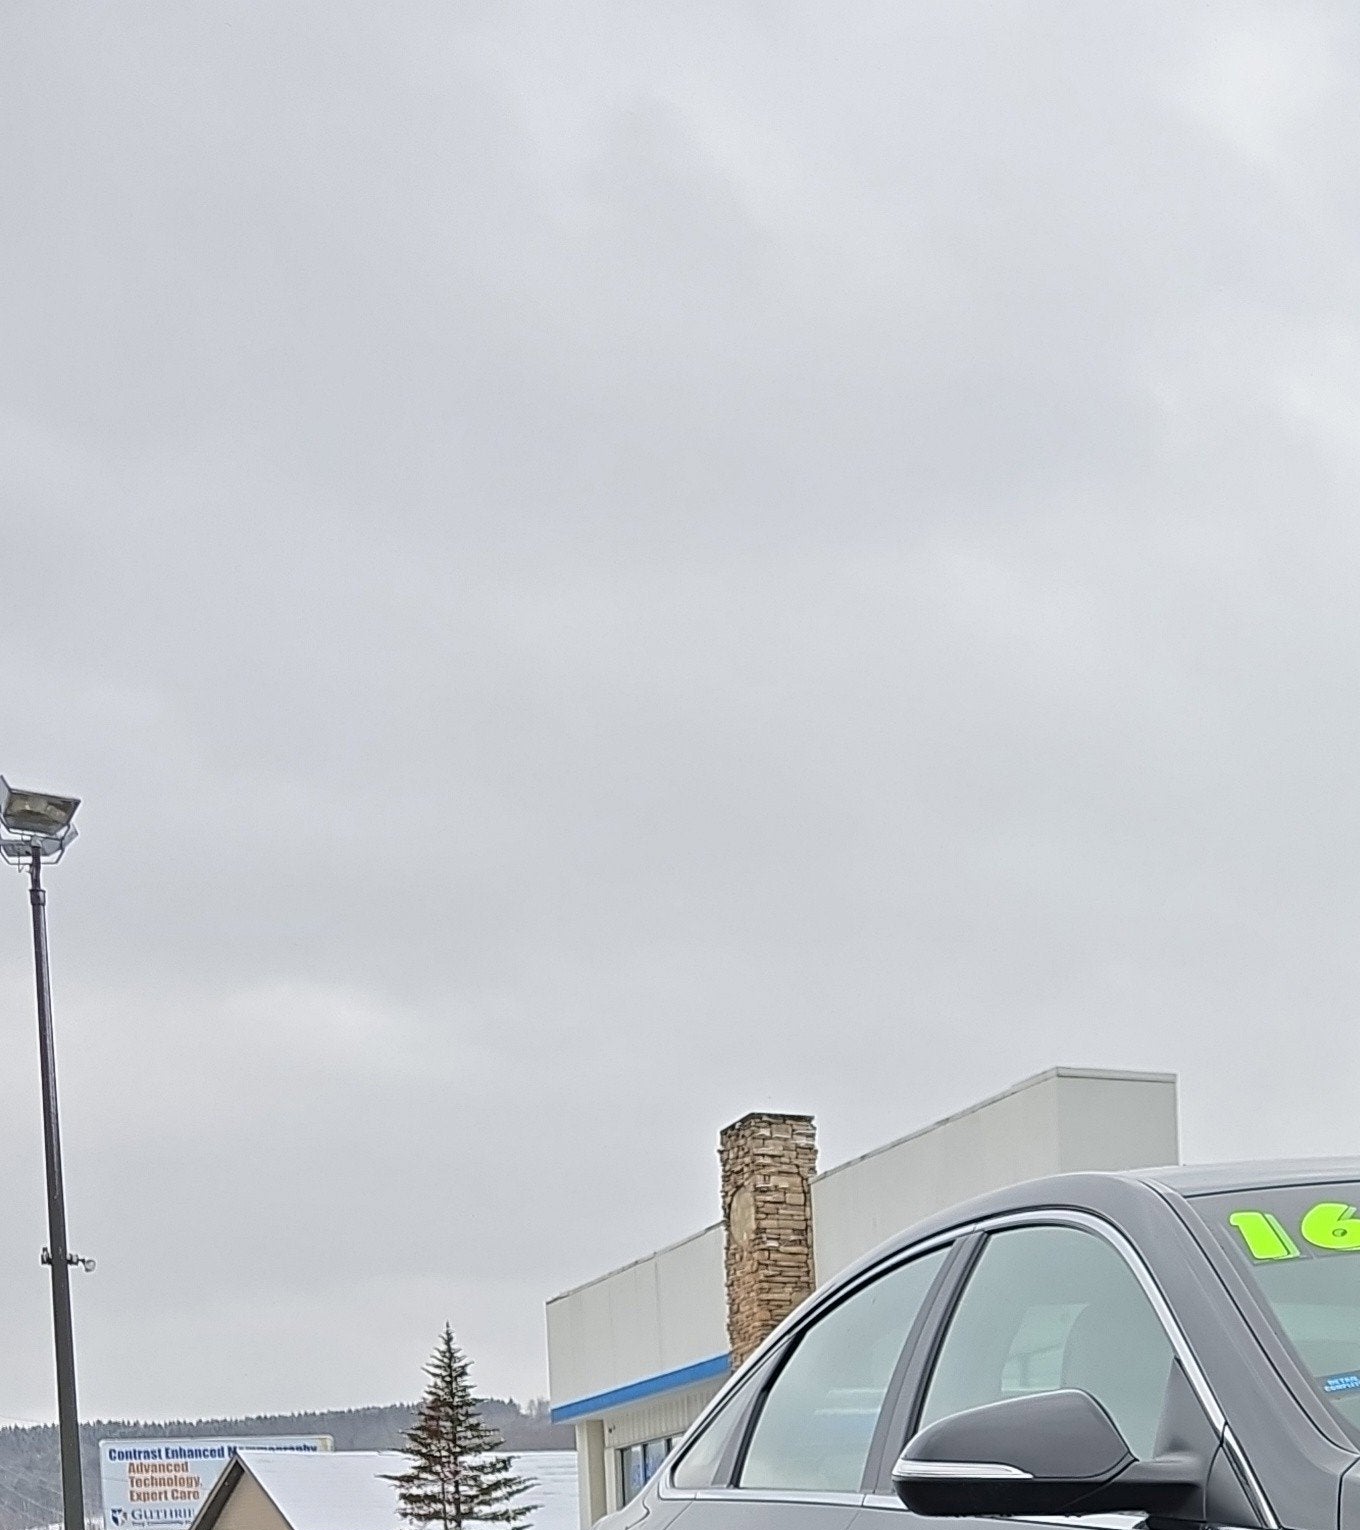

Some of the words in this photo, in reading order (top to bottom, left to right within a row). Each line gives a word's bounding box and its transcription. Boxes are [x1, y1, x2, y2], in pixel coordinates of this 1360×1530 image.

[108, 1448, 162, 1461] Contrast
[164, 1446, 225, 1459] Enhanced
[128, 1462, 189, 1474] Advanced
[129, 1490, 168, 1502] Expert
[171, 1489, 200, 1500] Care
